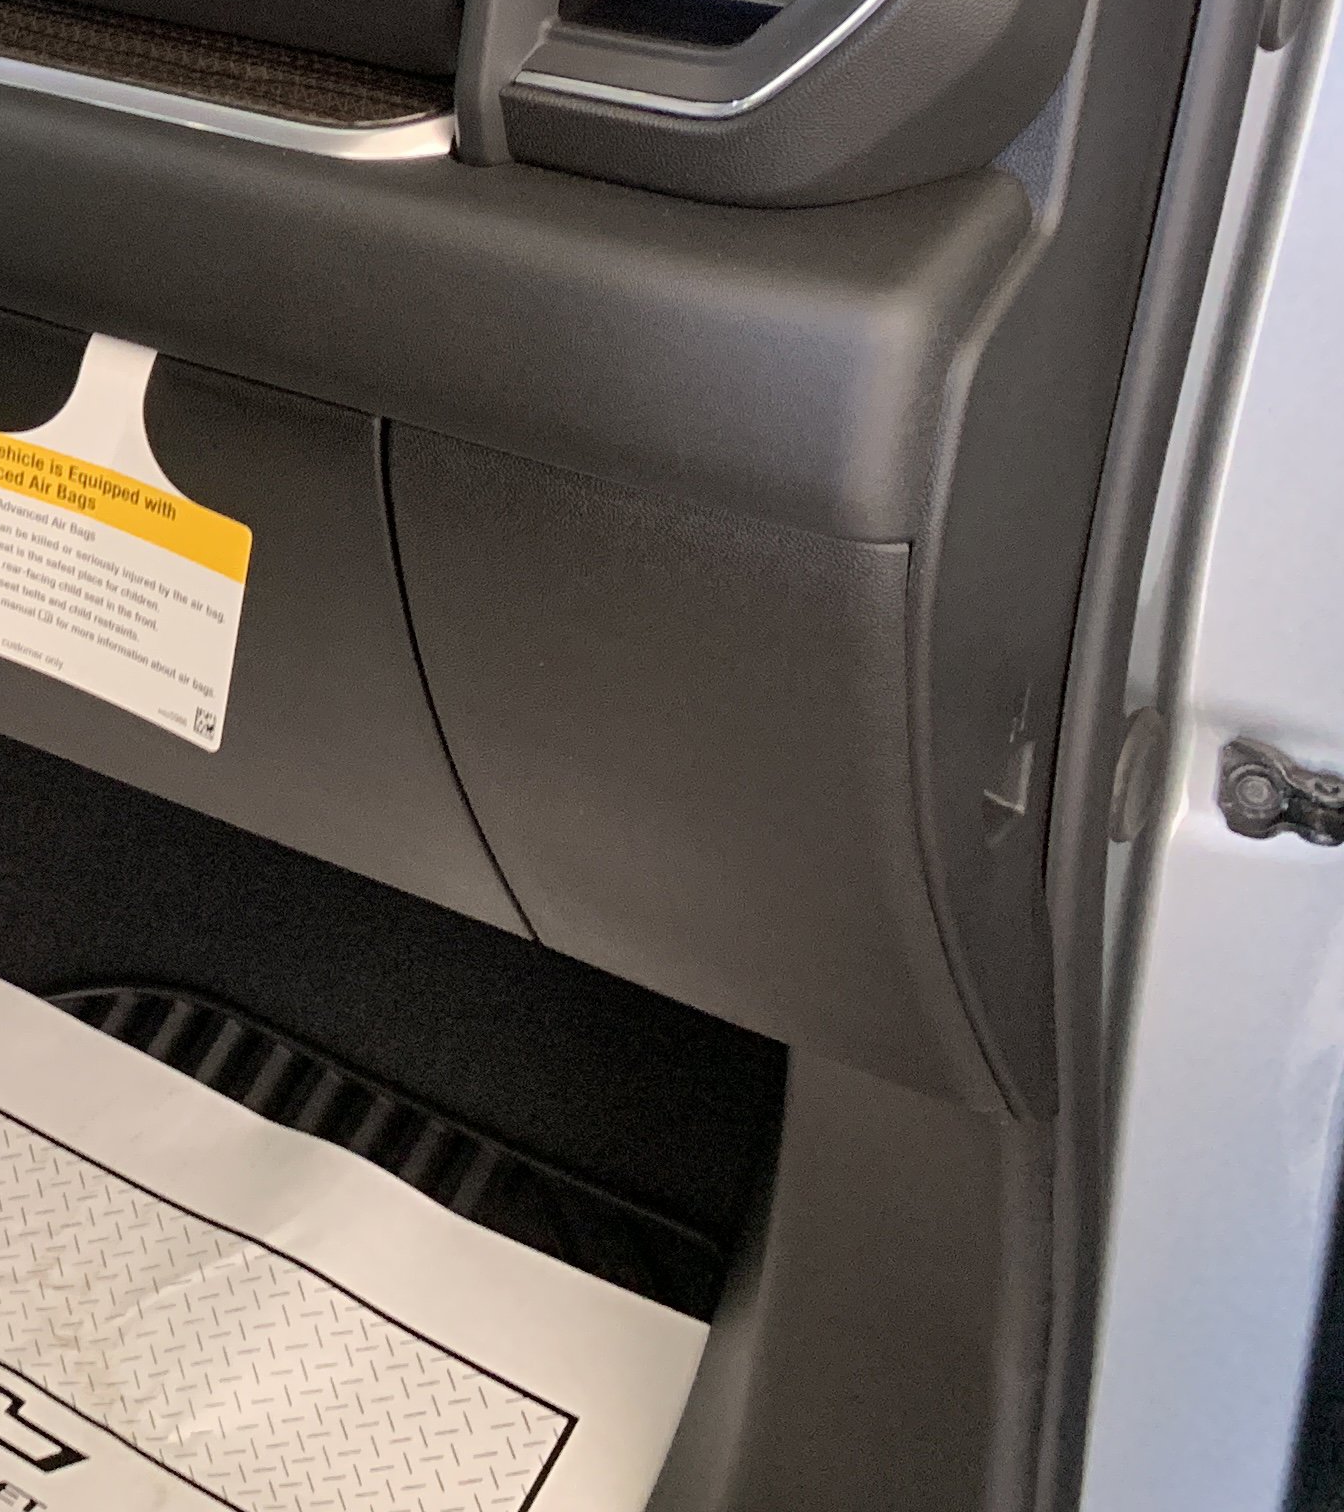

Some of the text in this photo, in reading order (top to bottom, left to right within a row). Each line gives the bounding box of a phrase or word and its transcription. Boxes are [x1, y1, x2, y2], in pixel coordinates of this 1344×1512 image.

[28, 474, 52, 495] Air
[57, 482, 96, 511] Bags
[50, 458, 63, 477] is
[68, 465, 140, 505] Equipped
[144, 496, 177, 521] with
[52, 516, 66, 530] Air
[70, 522, 96, 542] Bags
[2, 561, 56, 589] rear-facing
[59, 581, 82, 598] child
[84, 592, 104, 606] seat
[106, 600, 115, 612] in
[117, 604, 132, 619] the
[15, 528, 28, 541] be
[31, 532, 60, 551] killed
[62, 545, 73, 556] or
[76, 549, 120, 576] seriously
[122, 567, 156, 591] injured
[159, 583, 171, 598] by
[173, 588, 189, 605] the
[190, 598, 204, 612] air
[16, 547, 25, 558] is
[28, 550, 43, 564] the
[46, 557, 75, 576] safest
[77, 570, 103, 587] place
[105, 579, 119, 592] for
[0, 578, 20, 593] seat
[22, 586, 46, 602] belts
[48, 597, 67, 610] and
[69, 605, 92, 621] child
[0, 598, 36, 619] manual
[56, 617, 69, 629] for
[71, 625, 95, 641] more
[97, 634, 149, 666] information
[151, 659, 176, 679] about
[178, 673, 190, 686] air
[1, 639, 43, 660] customer
[45, 655, 64, 671] only
